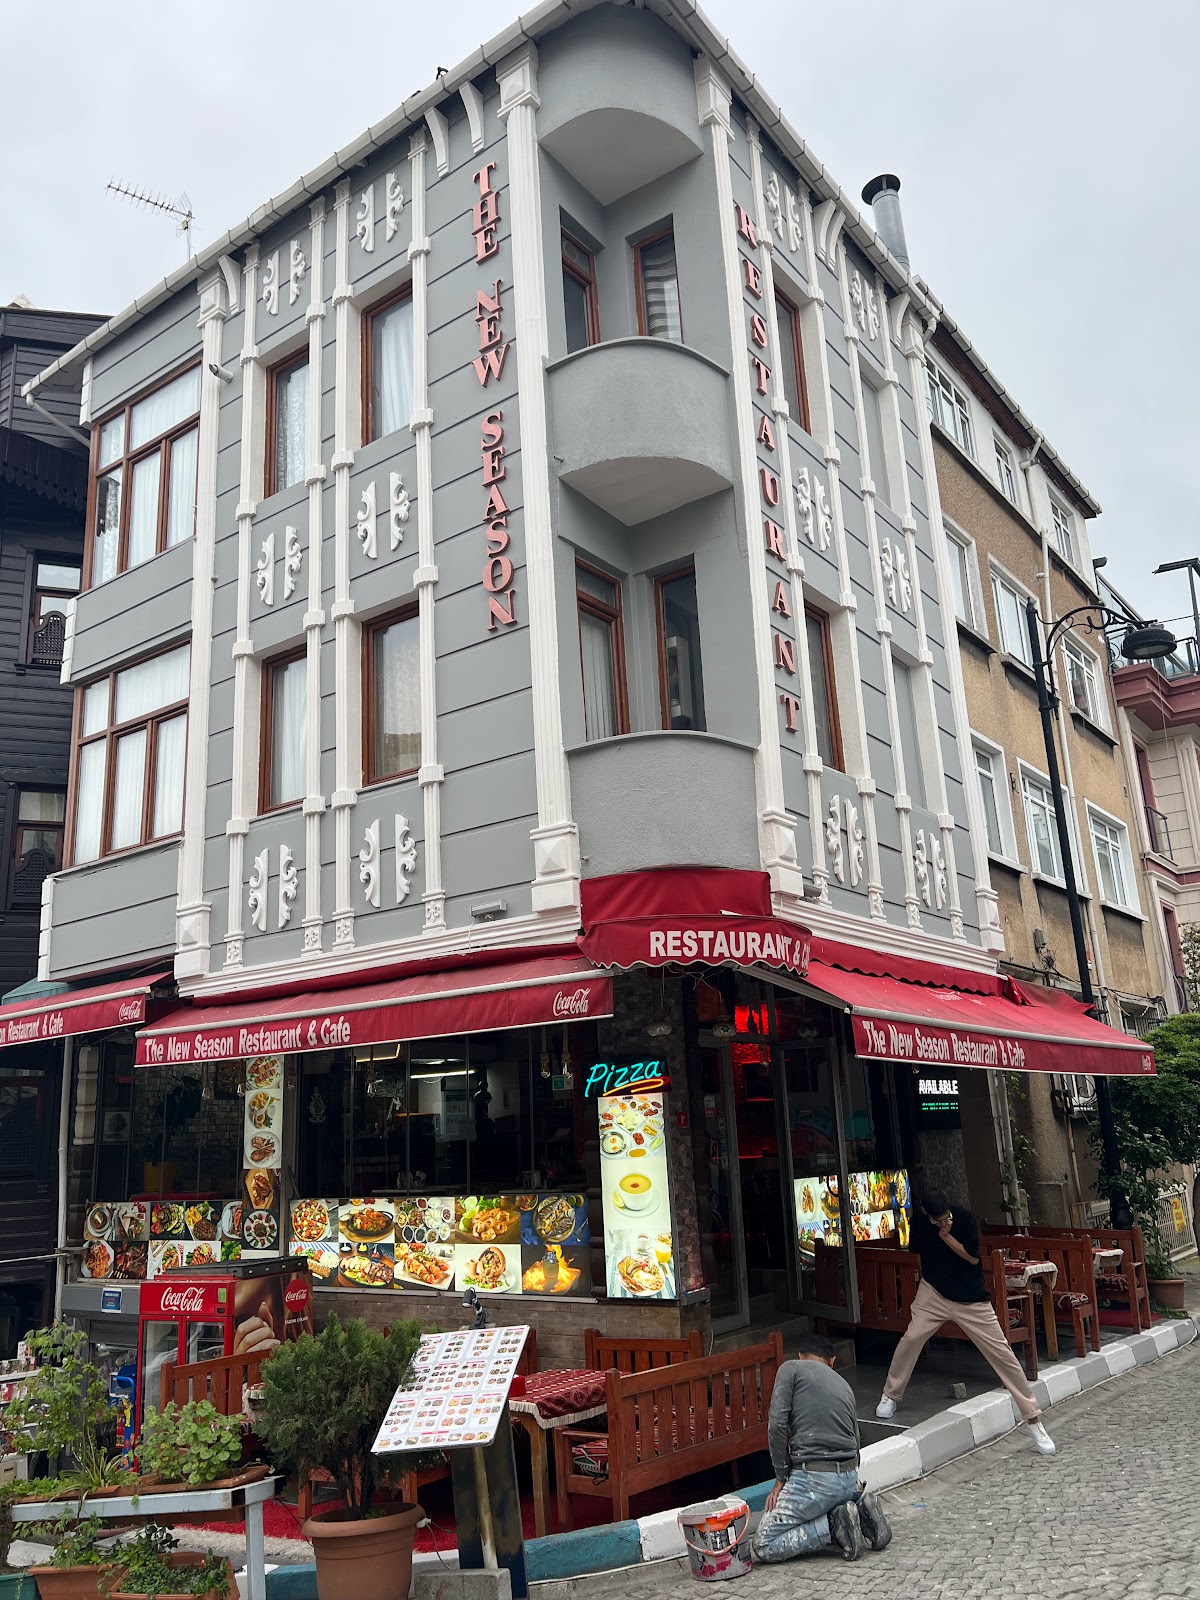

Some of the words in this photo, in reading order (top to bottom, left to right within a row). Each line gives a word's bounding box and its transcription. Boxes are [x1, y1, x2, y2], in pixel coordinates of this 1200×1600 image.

[471, 160, 502, 266] THE
[471, 279, 511, 388] NEW
[735, 205, 800, 733] RESTAURANT
[480, 410, 518, 633] SEASON
[650, 930, 793, 962] RESTAURANT
[793, 940, 801, 966] &
[118, 1000, 142, 1022] Coca-Cola
[552, 988, 591, 1017] Coca-Cola
[8, 1017, 40, 1042] Restaurant
[42, 1014, 48, 1036] &
[49, 1011, 64, 1035] Cafe
[145, 1038, 164, 1063] The
[167, 1036, 191, 1061] New
[194, 1033, 234, 1059] Season
[239, 1022, 302, 1055] Restaurant
[307, 1019, 318, 1047] &
[320, 1015, 351, 1045] Cafe
[862, 1020, 886, 1055] The
[887, 1023, 914, 1057] New
[914, 1027, 951, 1061] Season
[950, 1032, 999, 1065] Restaurant
[998, 1039, 1008, 1066] &
[1006, 1040, 1026, 1068] Cafe
[584, 1059, 662, 1097] Pizza
[918, 1079, 960, 1095] AVAILABLE
[160, 1286, 205, 1312] Coca-Cola
[285, 1288, 308, 1303] Coca-Cola
